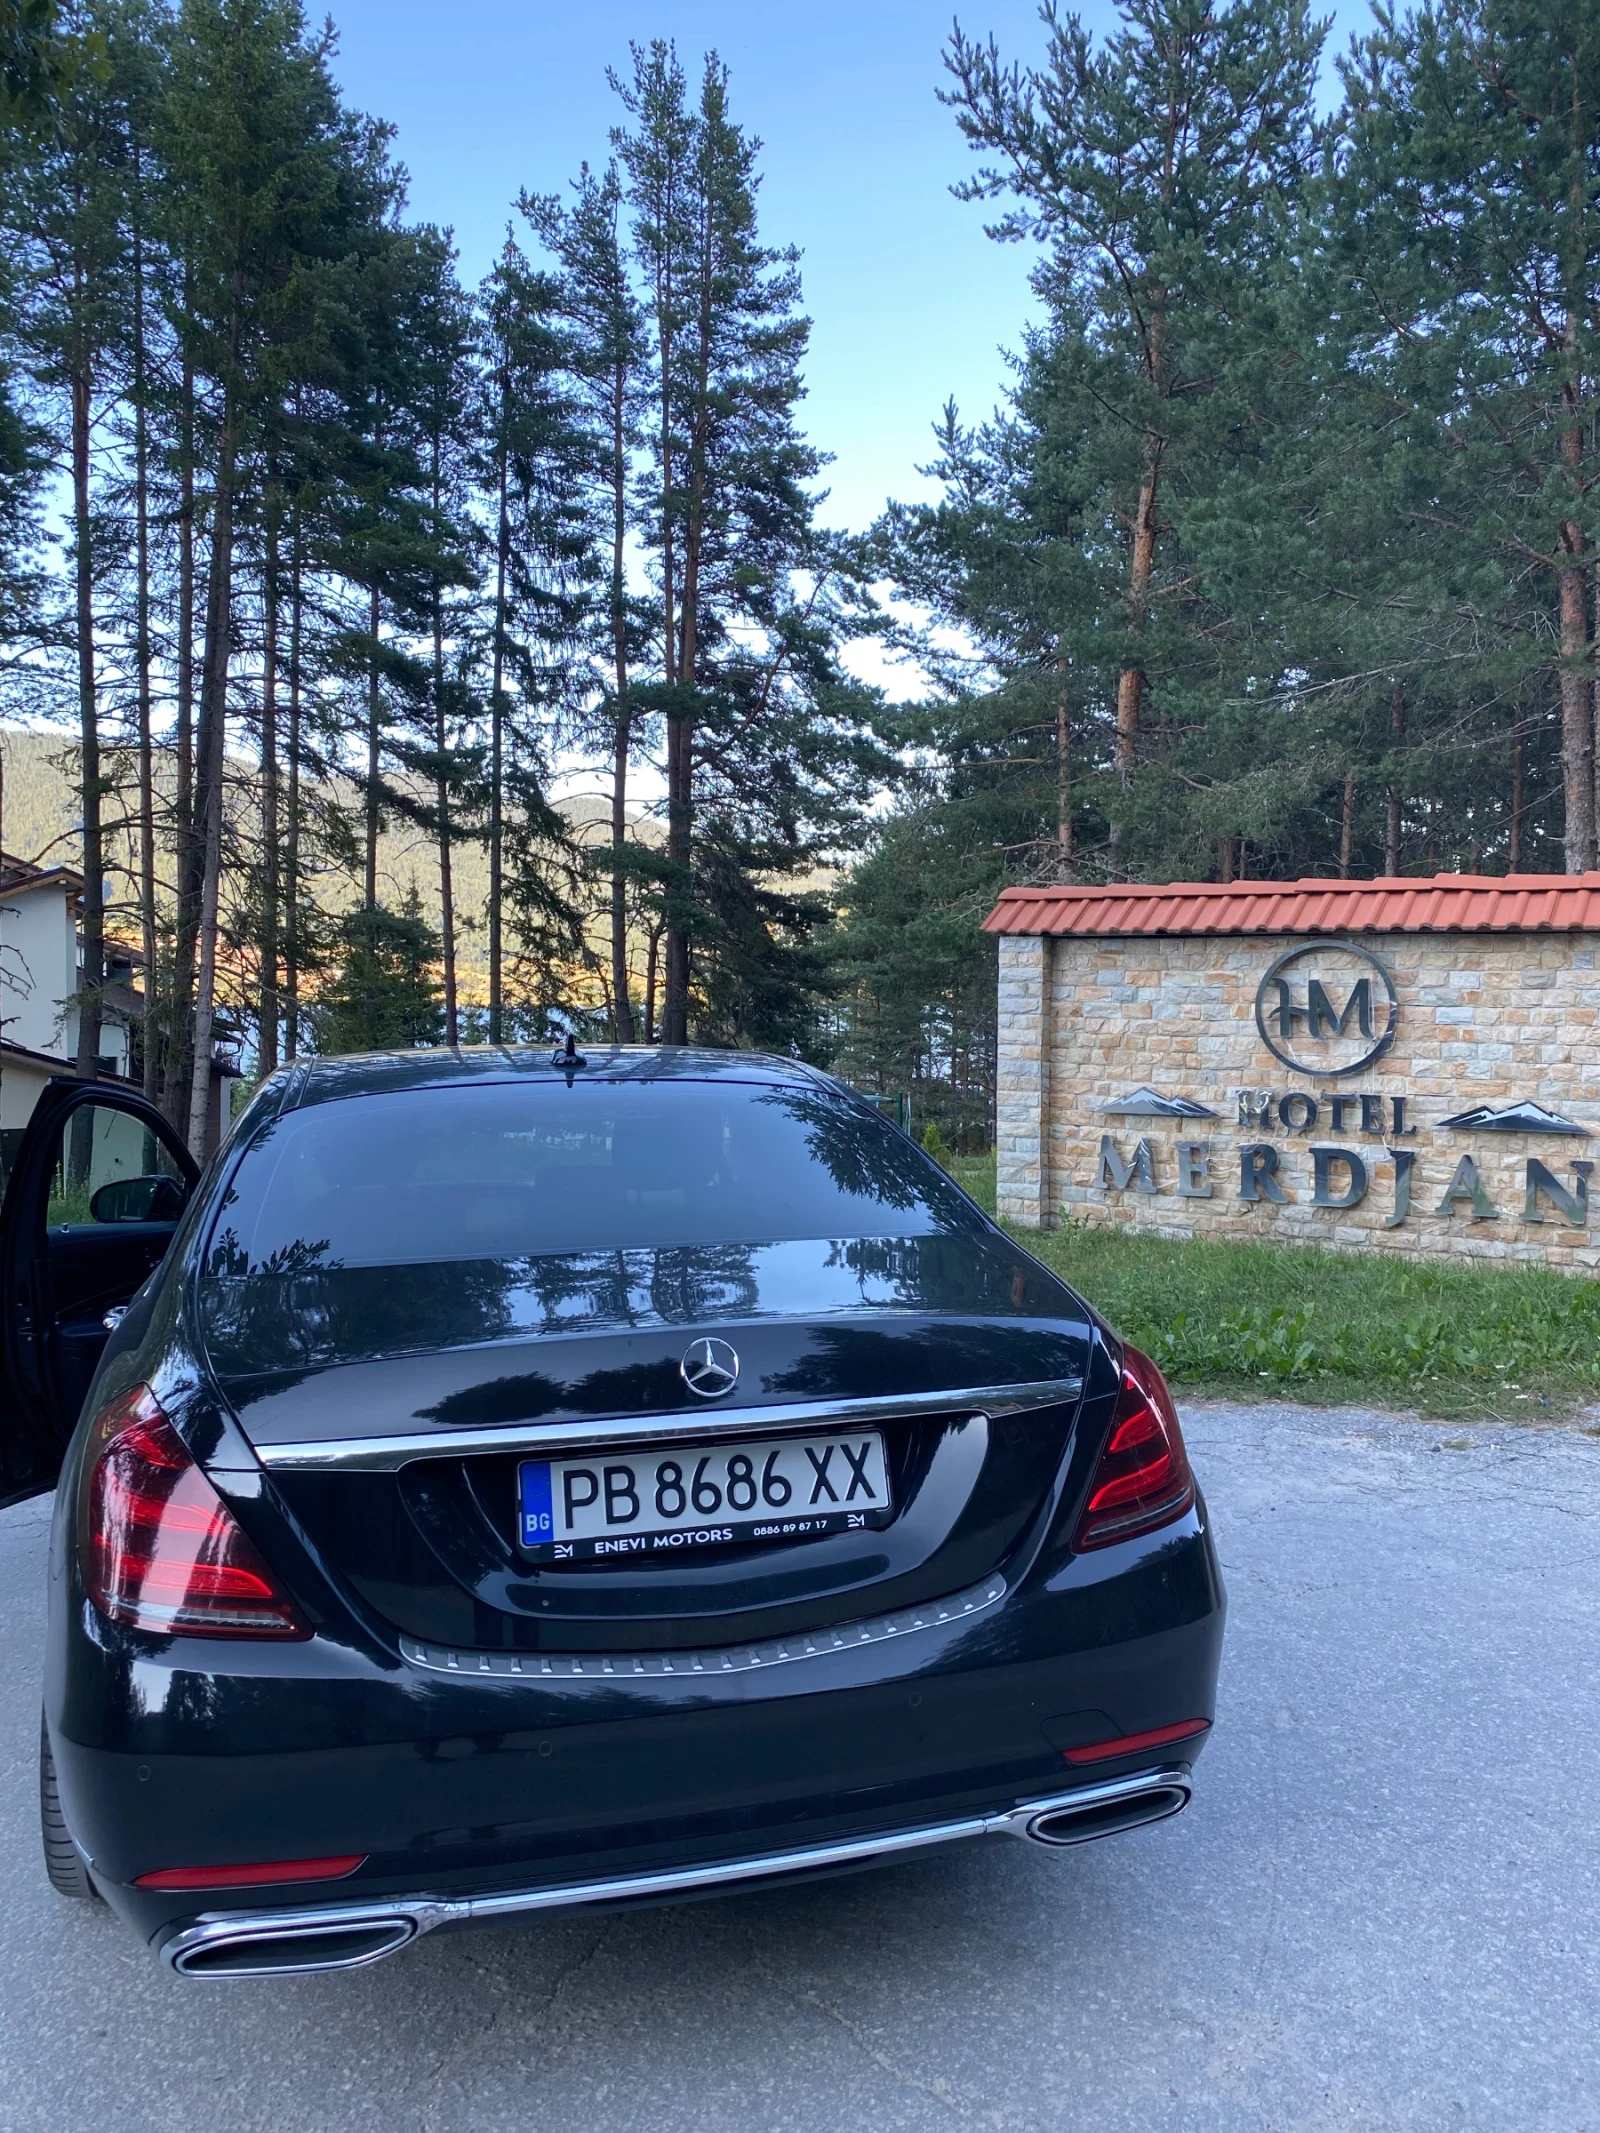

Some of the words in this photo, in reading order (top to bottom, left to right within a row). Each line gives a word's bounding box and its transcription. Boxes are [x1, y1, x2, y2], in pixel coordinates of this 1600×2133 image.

[1236, 1088, 1418, 1136] HOTEL
[1092, 1135, 1595, 1227] MERDJAN
[562, 1465, 640, 1530] PB
[655, 1450, 792, 1518] 8686
[804, 1442, 876, 1505] XX
[526, 1512, 551, 1532] BG
[753, 1525, 780, 1536] 0886
[782, 1523, 796, 1533] 89
[798, 1521, 811, 1531] 87
[815, 1520, 828, 1529] 17
[594, 1537, 646, 1554] ENEVI
[653, 1528, 733, 1547] MOTORS
